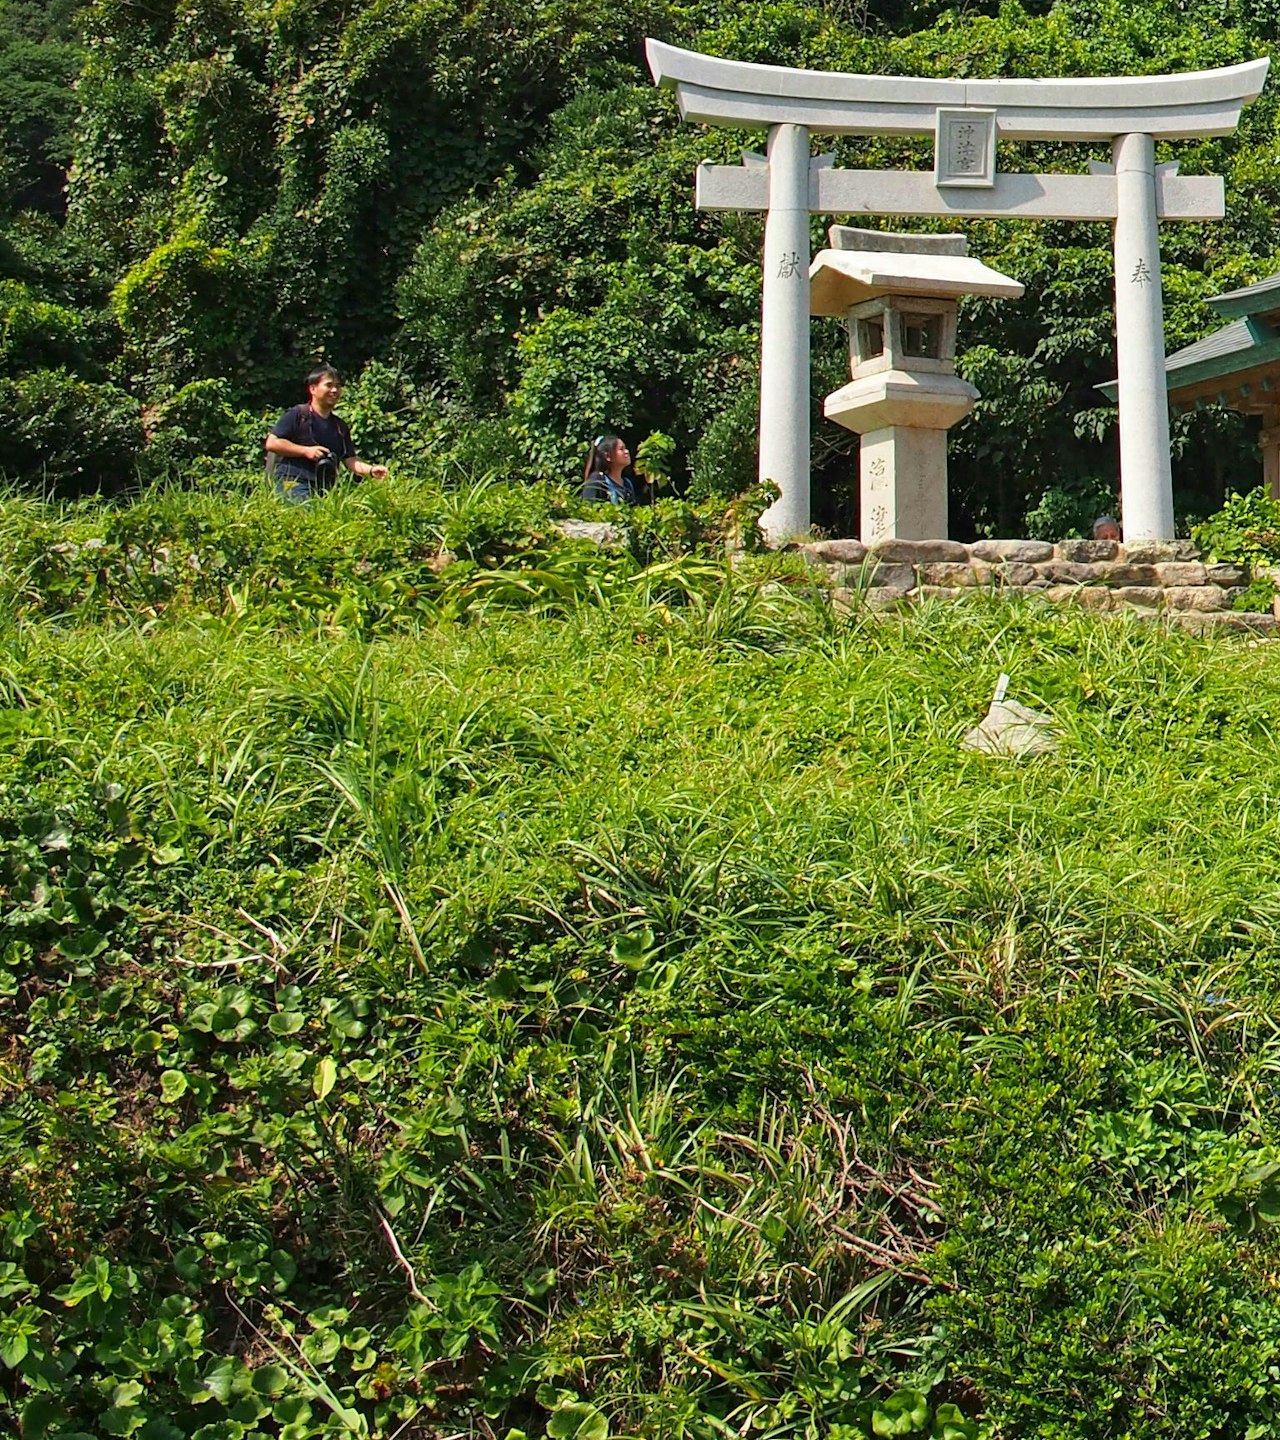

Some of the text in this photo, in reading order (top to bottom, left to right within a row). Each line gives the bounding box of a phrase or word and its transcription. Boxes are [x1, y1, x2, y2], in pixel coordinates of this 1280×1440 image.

[956, 124, 976, 170] 沖津宮
[1131, 258, 1153, 288] 奉
